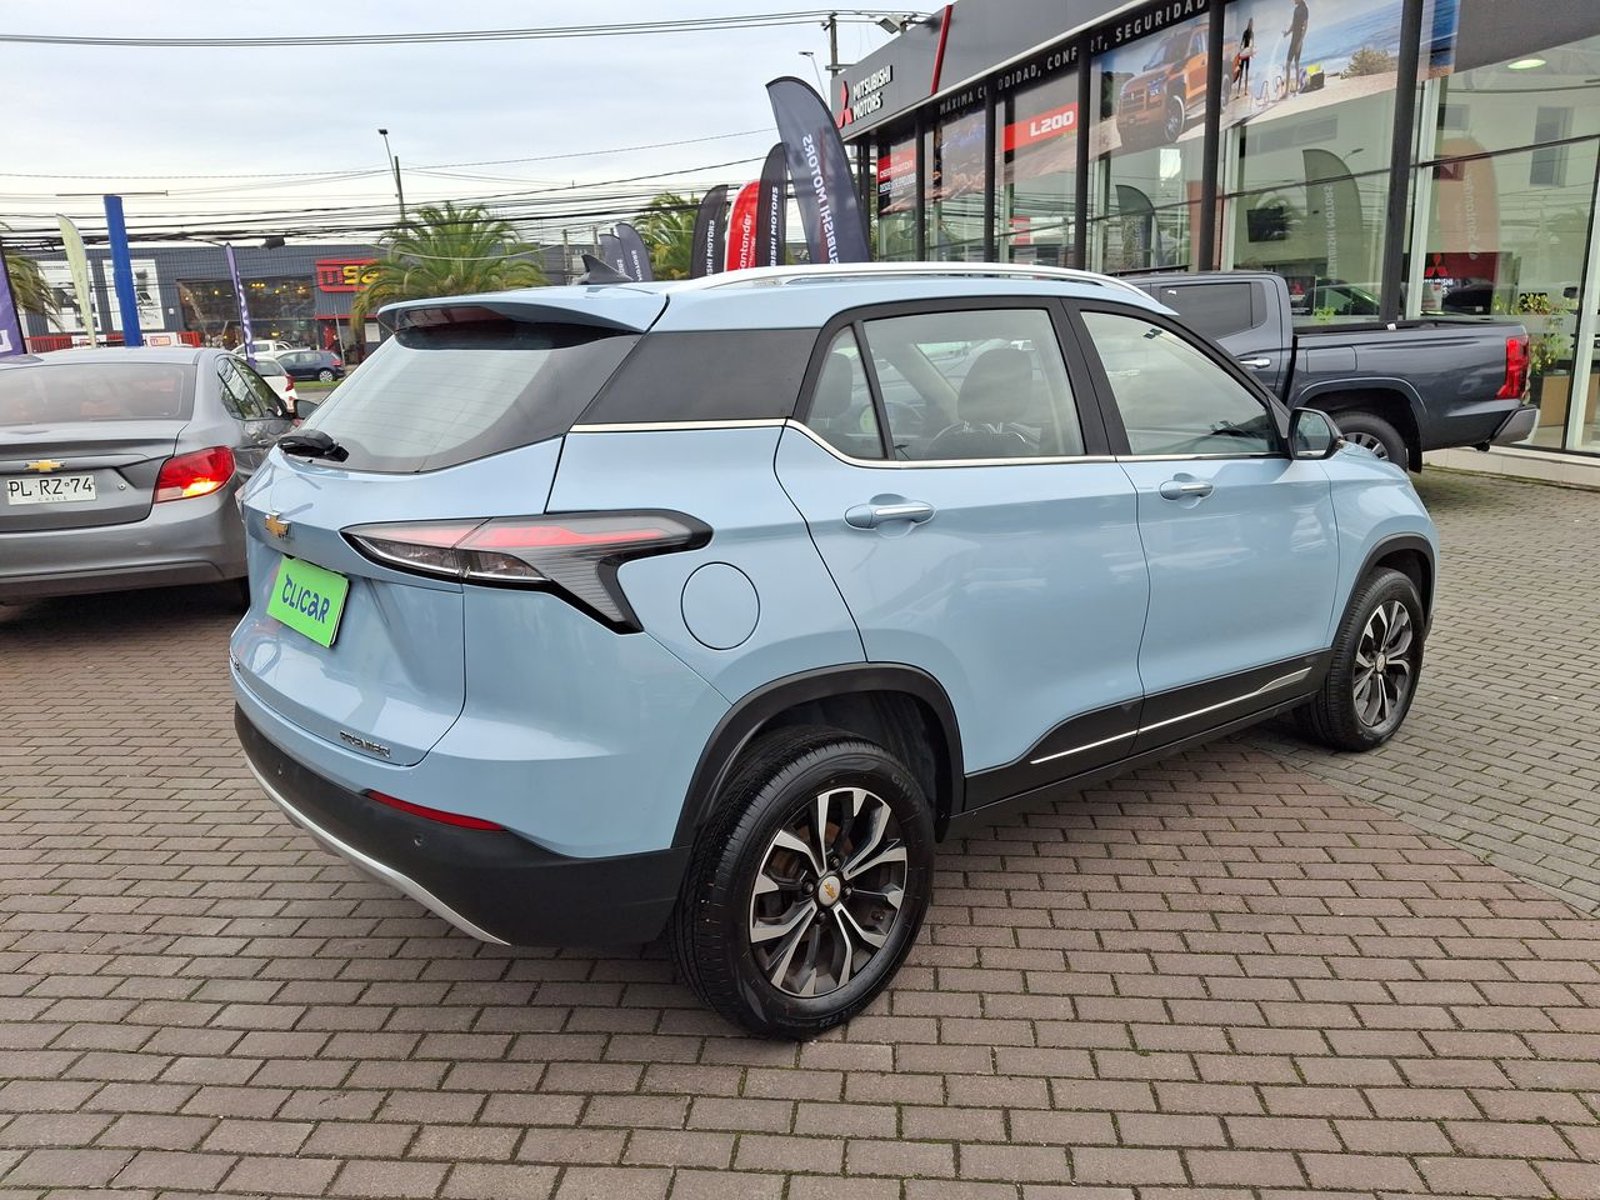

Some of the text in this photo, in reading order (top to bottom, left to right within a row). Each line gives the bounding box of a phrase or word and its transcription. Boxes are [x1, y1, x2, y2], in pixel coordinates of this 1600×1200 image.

[1115, 0, 1205, 43] SEGURIDAD
[853, 64, 893, 101] MITSUBISHI
[853, 91, 883, 121] MOTORS
[1029, 110, 1075, 137] L200
[770, 185, 780, 236] MOTORS
[706, 219, 716, 257] MOTORS
[70, 477, 93, 493] 74
